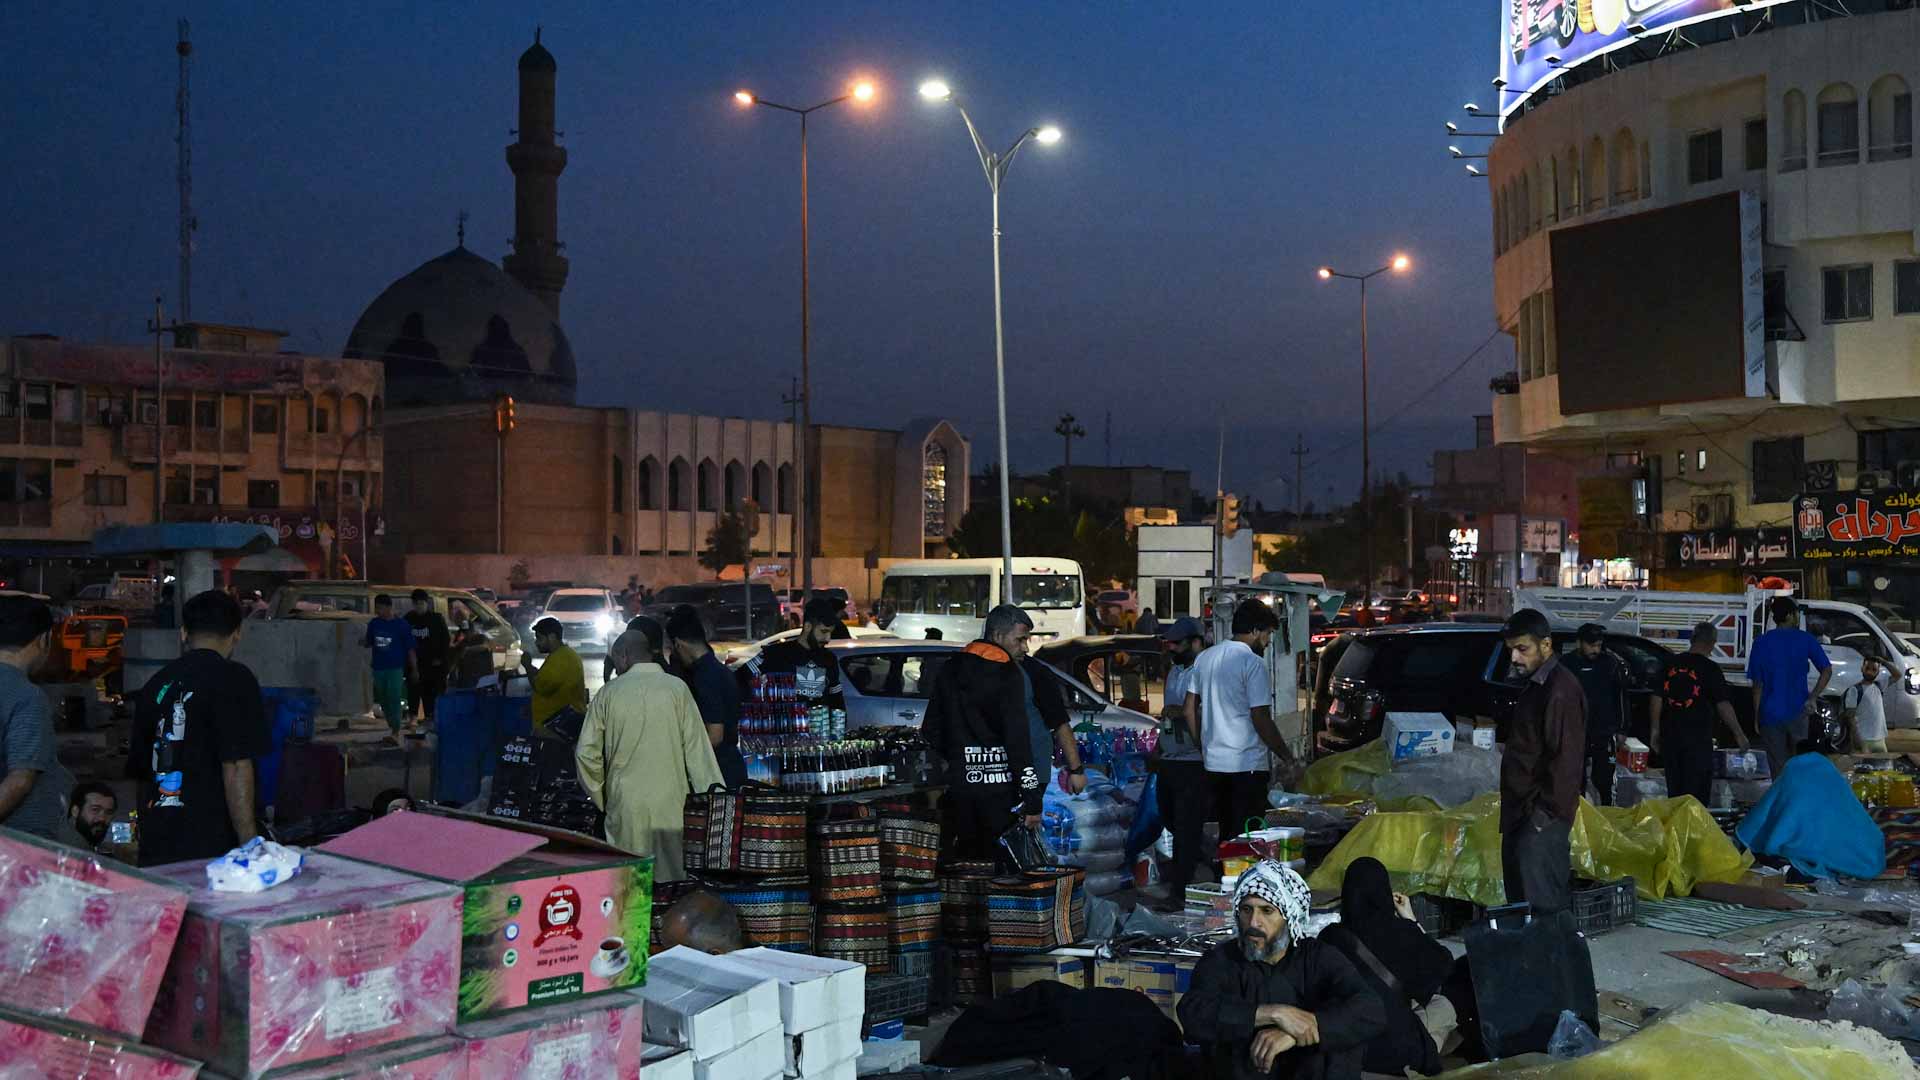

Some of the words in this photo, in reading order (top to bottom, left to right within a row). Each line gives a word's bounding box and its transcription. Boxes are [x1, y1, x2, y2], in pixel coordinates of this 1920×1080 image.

[1740, 535, 1788, 567] تصوير
[531, 989, 555, 1000] Premium
[555, 986, 570, 996] Black
[570, 985, 580, 993] Tea
